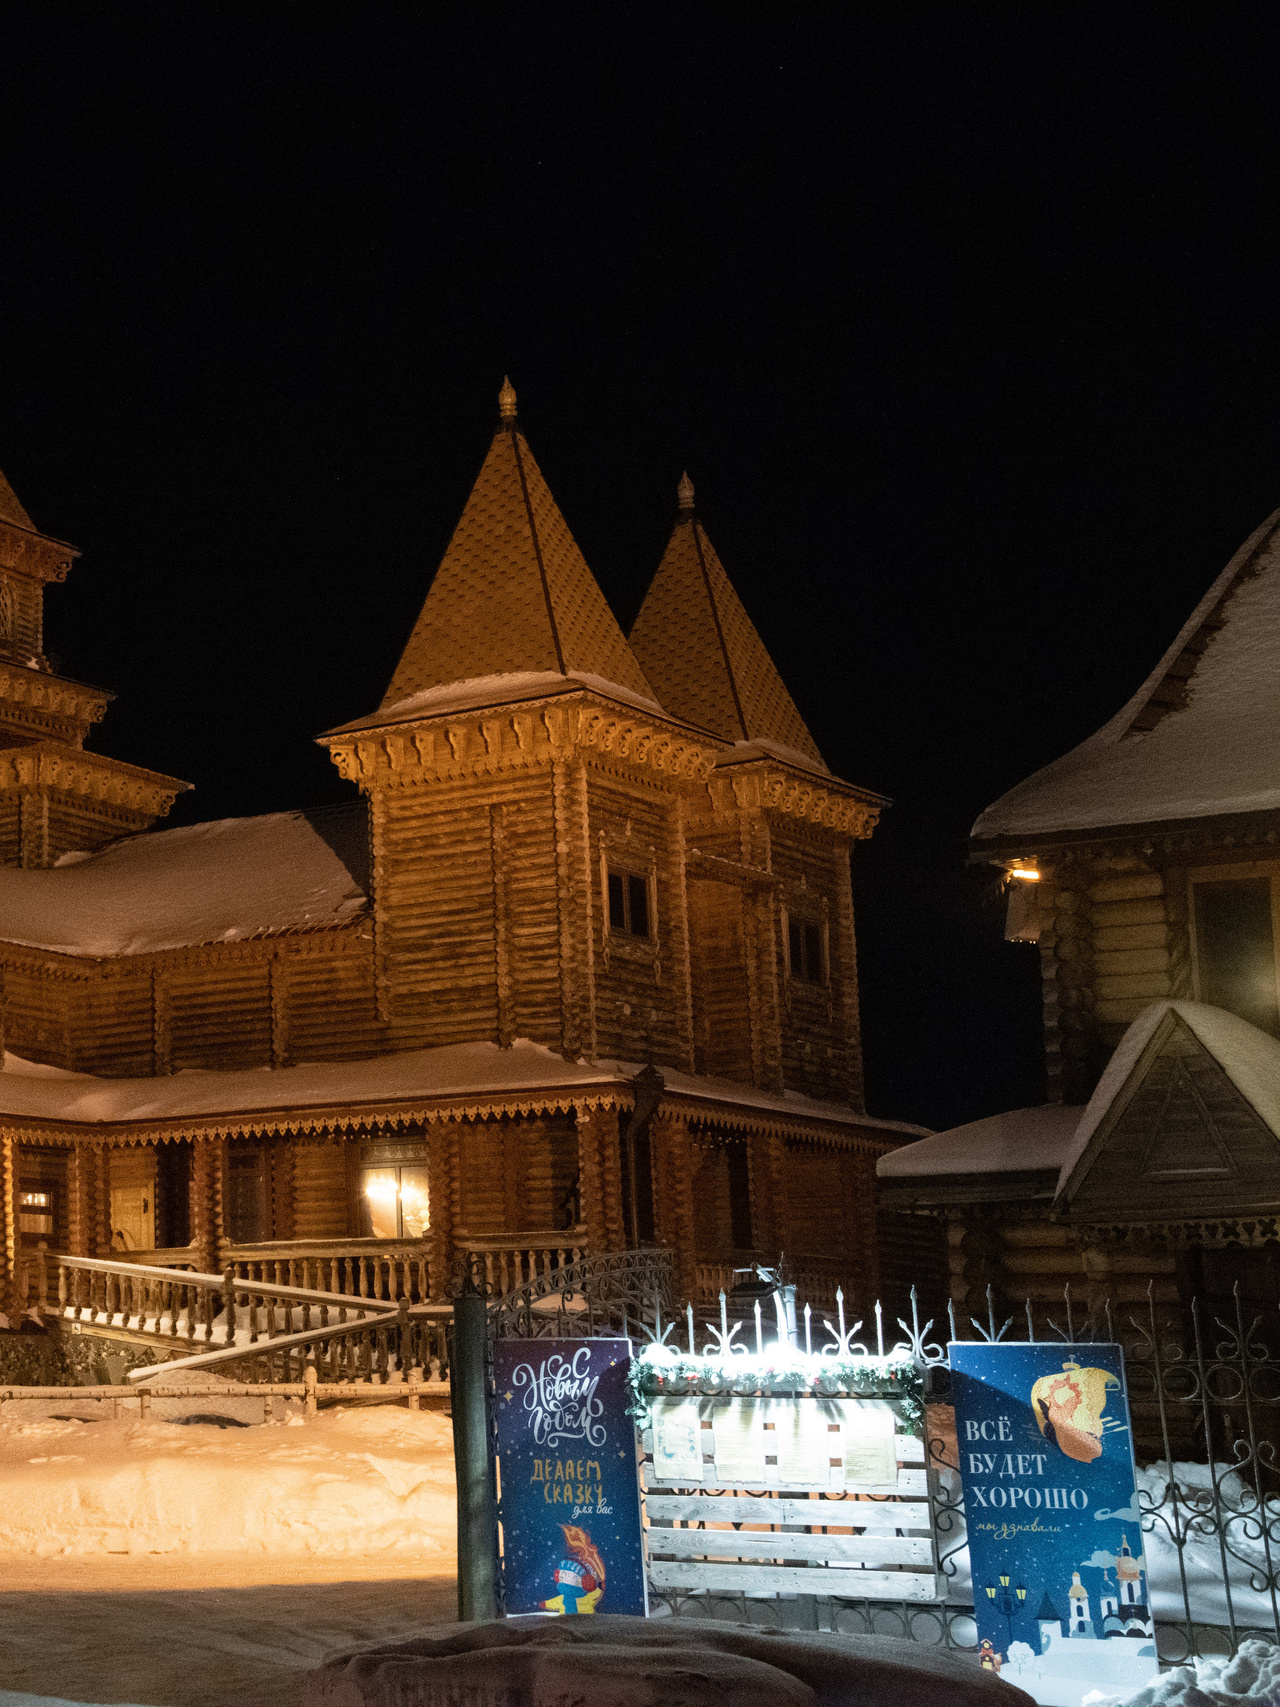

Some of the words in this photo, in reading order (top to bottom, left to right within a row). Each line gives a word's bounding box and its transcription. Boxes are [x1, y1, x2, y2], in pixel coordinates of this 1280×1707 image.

[512, 1354, 604, 1418] Новым
[964, 1415, 1013, 1442] ВСЁ
[530, 1458, 602, 1484] ДЕЛАЕМ
[968, 1453, 1048, 1479] БУДЕТ
[544, 1481, 603, 1505] СКАЗКУ
[971, 1486, 1089, 1510] ХОРОШО
[571, 1504, 593, 1519] для
[596, 1498, 613, 1515] вас
[975, 1522, 998, 1531] мы
